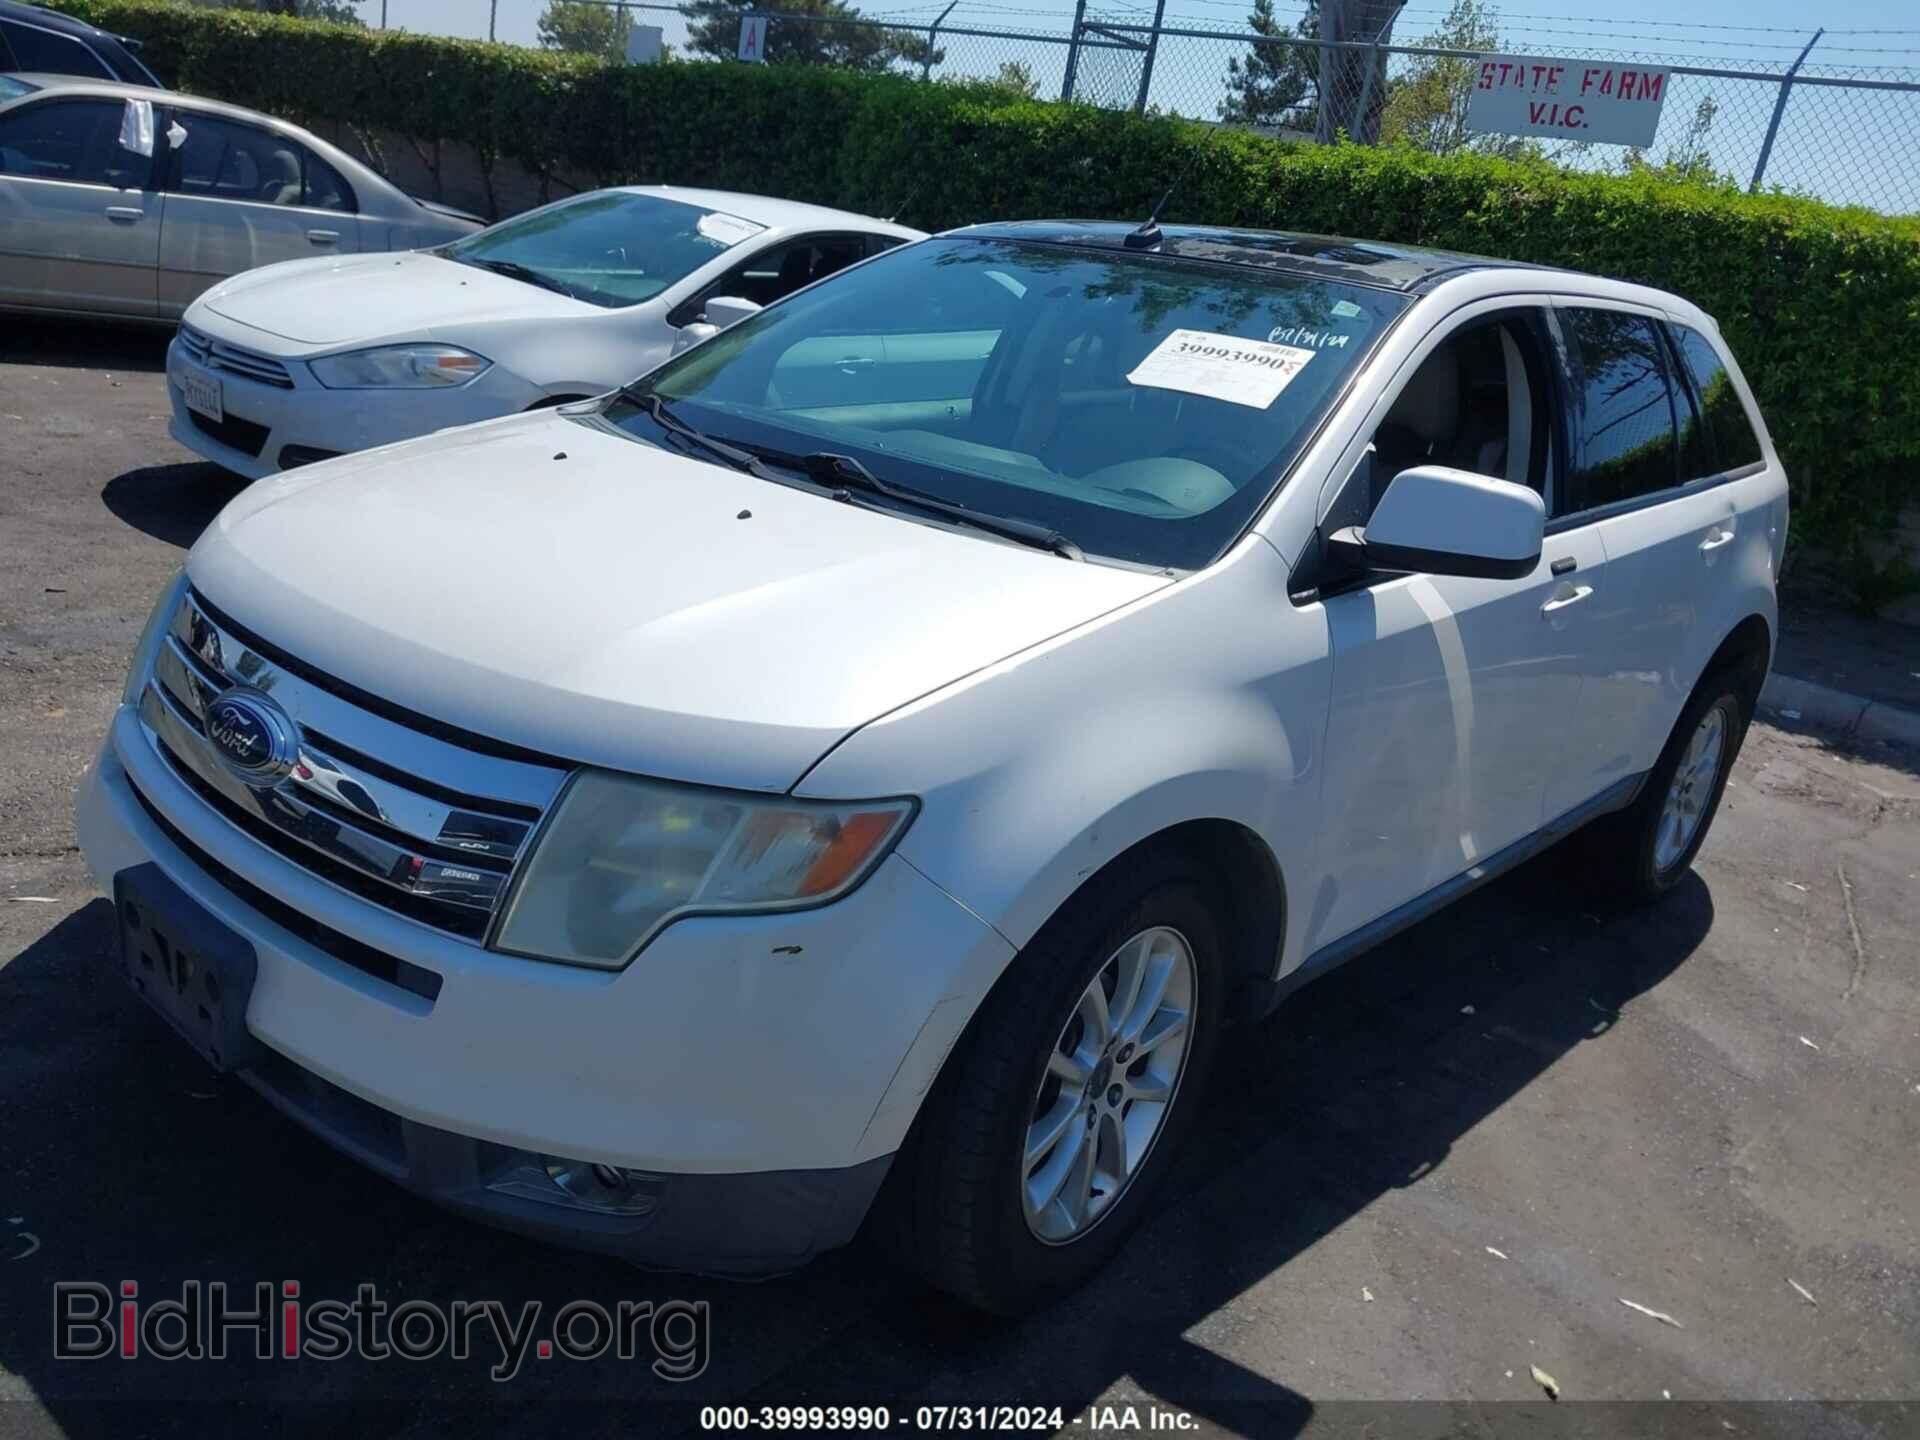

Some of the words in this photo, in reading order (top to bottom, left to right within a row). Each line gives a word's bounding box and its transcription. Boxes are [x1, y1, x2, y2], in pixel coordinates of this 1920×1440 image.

[744, 22, 757, 57] A
[1478, 63, 1565, 95] STATE
[1579, 69, 1665, 101] FARM
[1529, 101, 1589, 129] V.I.C.
[1171, 342, 1286, 370] 39993990
[210, 706, 259, 757] Ford
